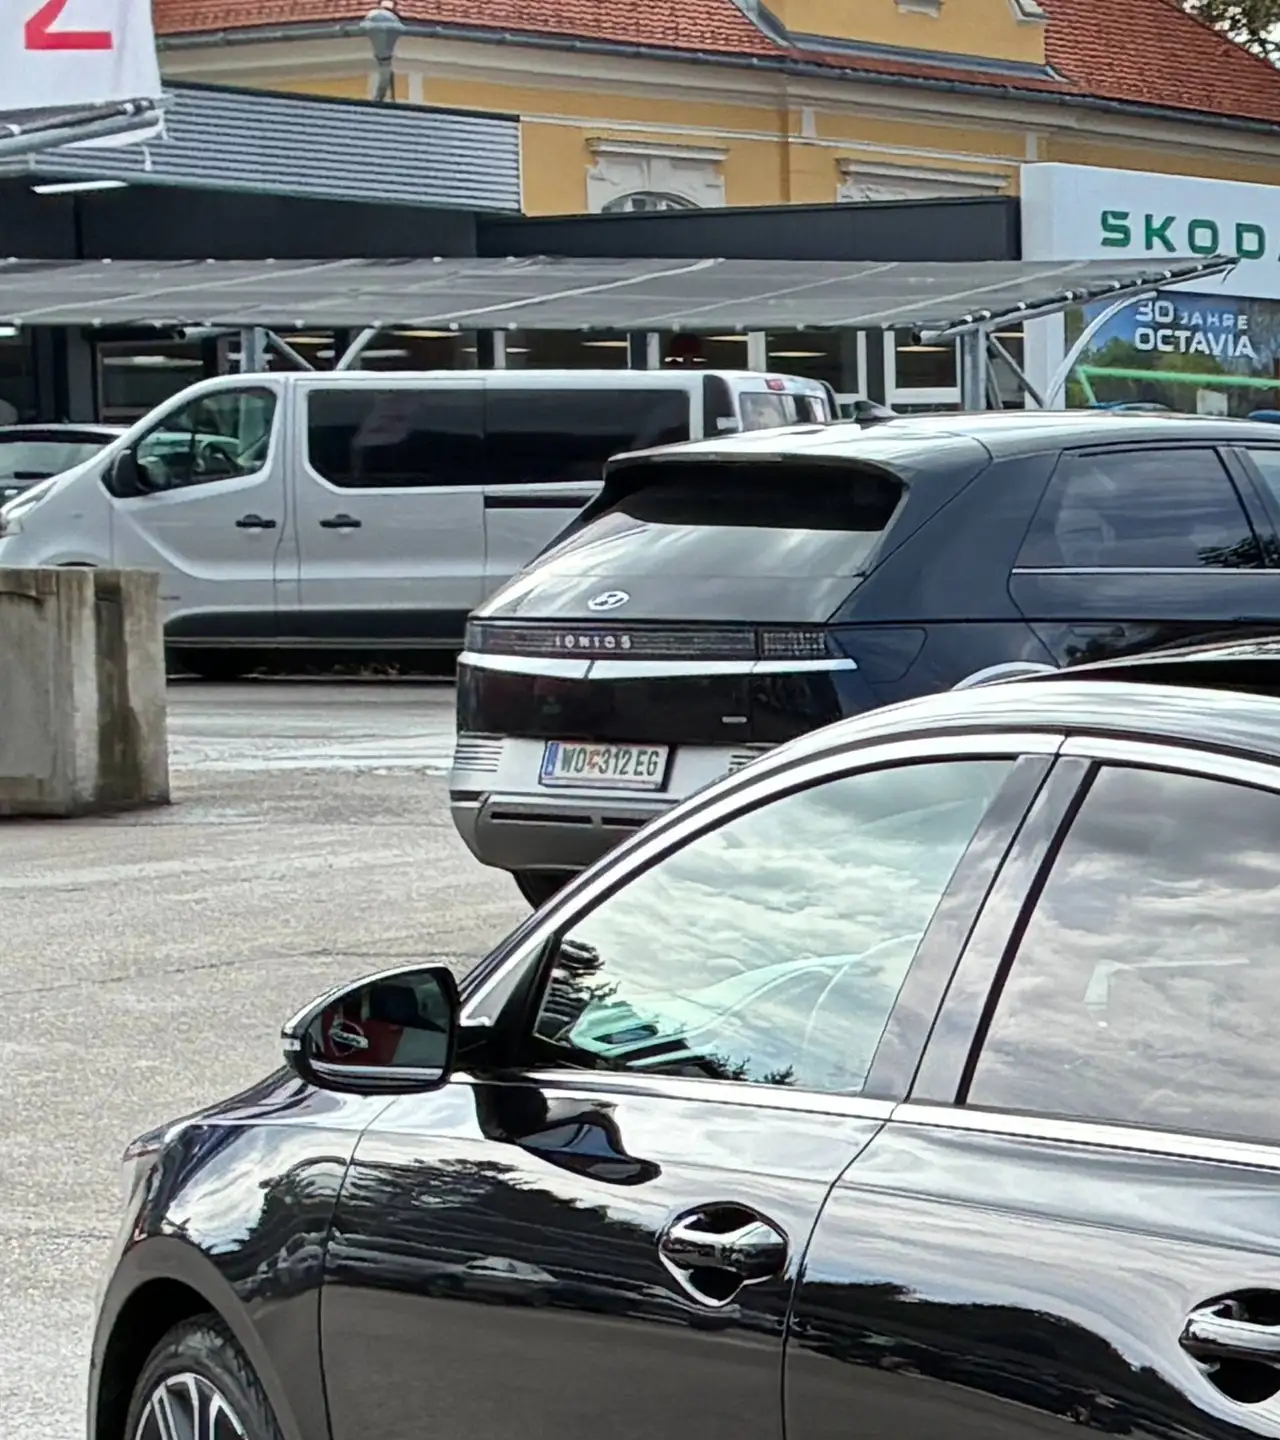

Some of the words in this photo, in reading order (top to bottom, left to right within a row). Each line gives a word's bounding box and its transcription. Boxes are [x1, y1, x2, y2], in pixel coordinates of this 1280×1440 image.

[1135, 300, 1174, 324] 30
[1180, 311, 1249, 330] JAHRE
[1134, 326, 1258, 359] OCTAVIA
[561, 747, 587, 774] WO
[598, 747, 633, 776] 312
[633, 750, 660, 776] EG
